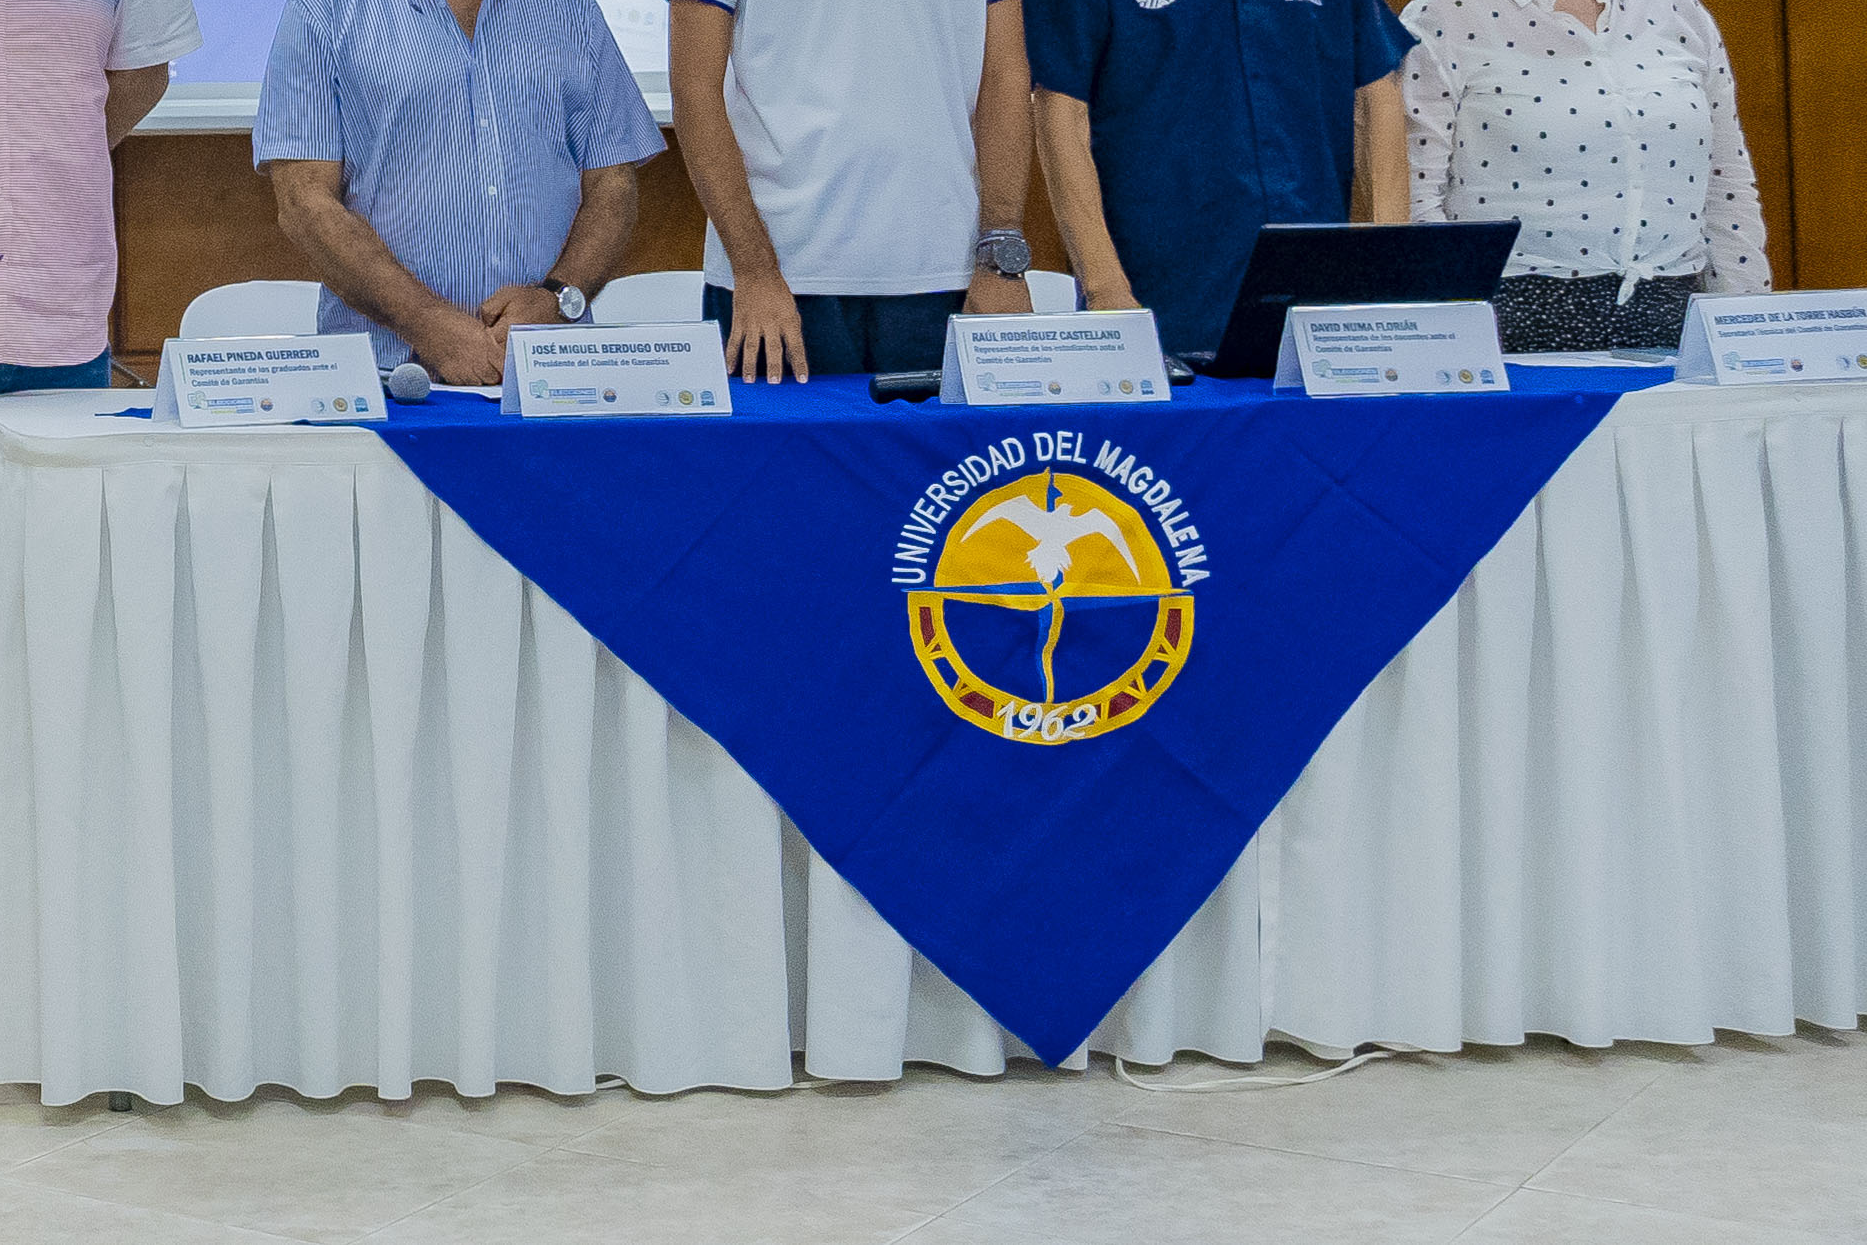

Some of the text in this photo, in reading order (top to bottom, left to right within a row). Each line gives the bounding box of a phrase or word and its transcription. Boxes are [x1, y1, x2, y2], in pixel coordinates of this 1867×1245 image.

[1714, 313, 1765, 325] MERCEDES
[1767, 312, 1781, 322] DE
[1782, 311, 1794, 322] LA
[1310, 319, 1418, 333] DAVID NUMA FLORIÁN
[972, 329, 1121, 342] RAÚL RODRÍGUEZ CASTELLANO
[531, 341, 691, 355] JOSÉ MIGUEL BERDUGO OVIEDO
[187, 349, 320, 364] RAFAEL PINEDA GUERRERO
[533, 359, 575, 368] Presidente
[577, 358, 589, 367] del
[591, 358, 619, 367] Comité
[620, 358, 630, 366] de
[189, 366, 246, 378] Representante
[247, 365, 257, 374] de
[259, 365, 270, 374] los
[271, 363, 311, 374] graduados
[312, 363, 329, 371] ante
[220, 377, 230, 386] de
[891, 430, 1211, 587] UNIVERSIDAD DEL MAGDALENA
[996, 699, 1098, 741] 1962
